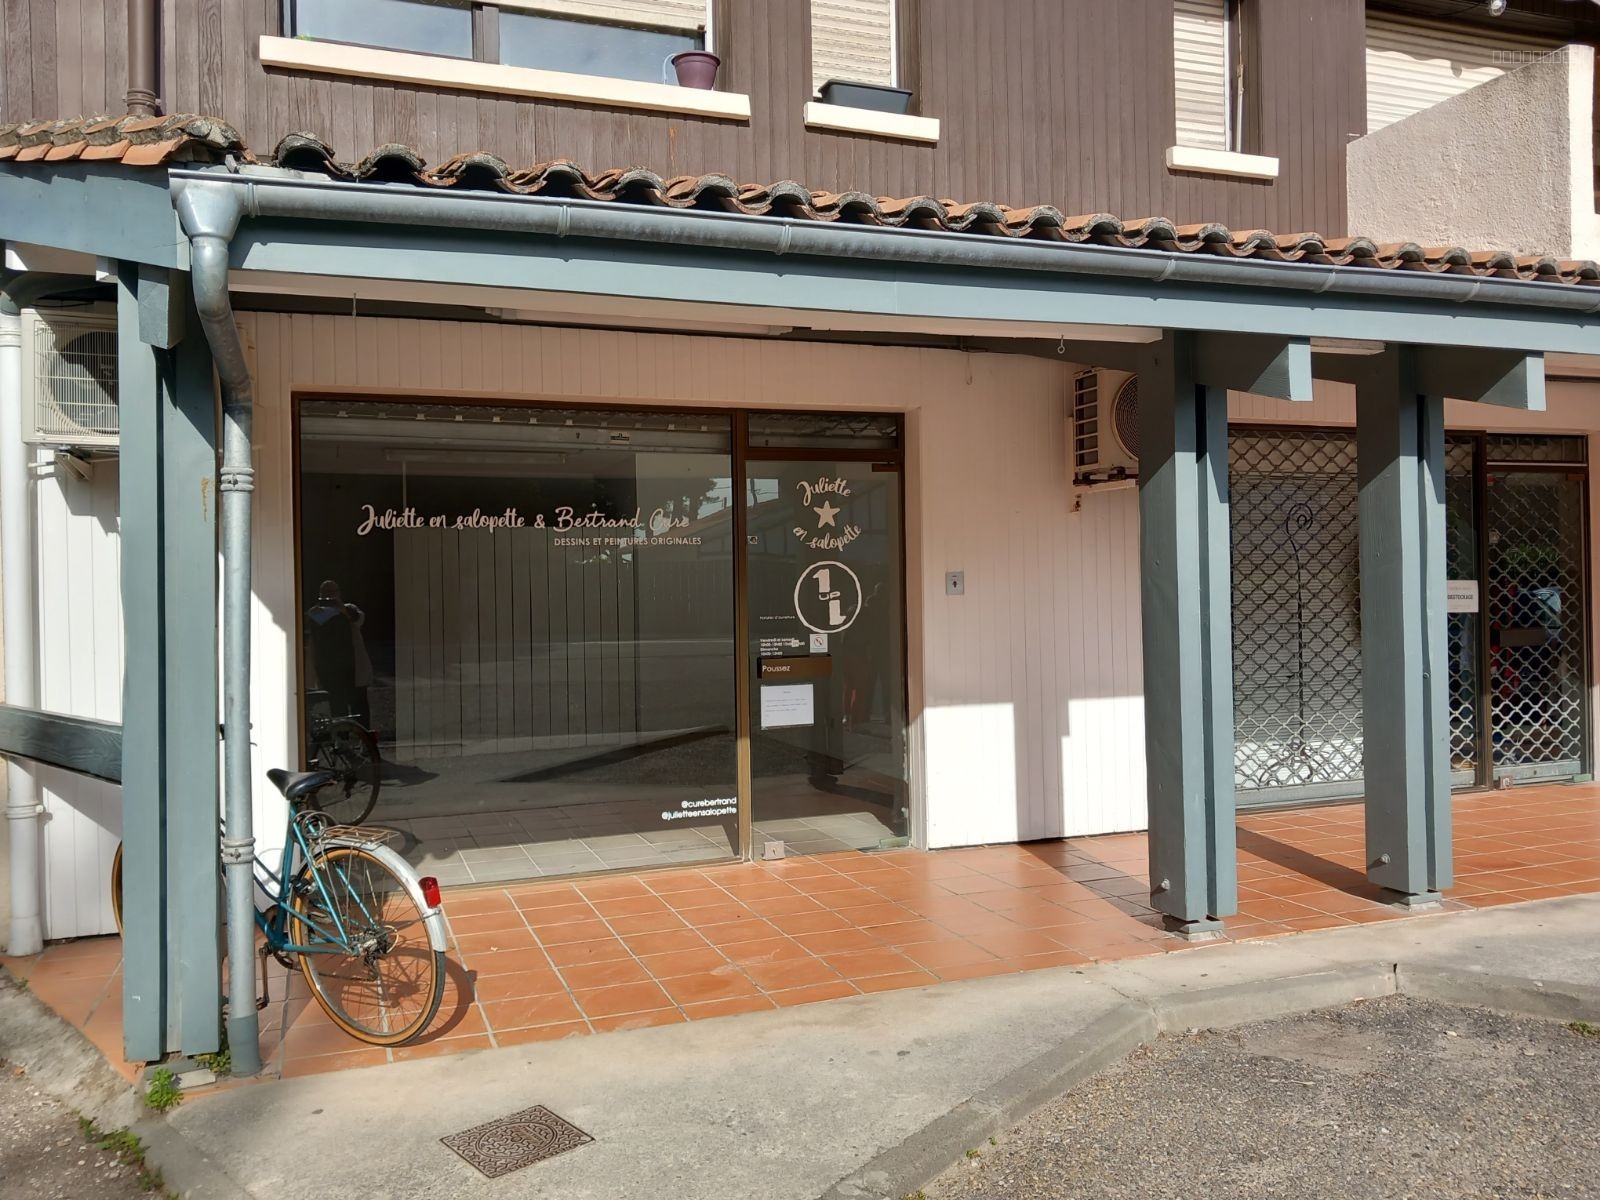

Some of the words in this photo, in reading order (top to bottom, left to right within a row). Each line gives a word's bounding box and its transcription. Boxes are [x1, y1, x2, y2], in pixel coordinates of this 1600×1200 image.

[797, 477, 852, 506] Juliette
[356, 504, 425, 536] Juliette
[429, 514, 446, 528] en
[451, 508, 525, 533] salopette
[534, 514, 546, 529] &
[553, 506, 643, 532] Bertrand
[554, 537, 590, 546] DESSINS
[592, 537, 602, 546] ET
[604, 537, 649, 546] PEINTURES
[650, 536, 702, 545] ORIGINALES
[793, 526, 808, 541] en
[805, 524, 861, 551] salopette
[681, 797, 737, 808] @curebertrand
[661, 806, 737, 821] @julietteensalopette
